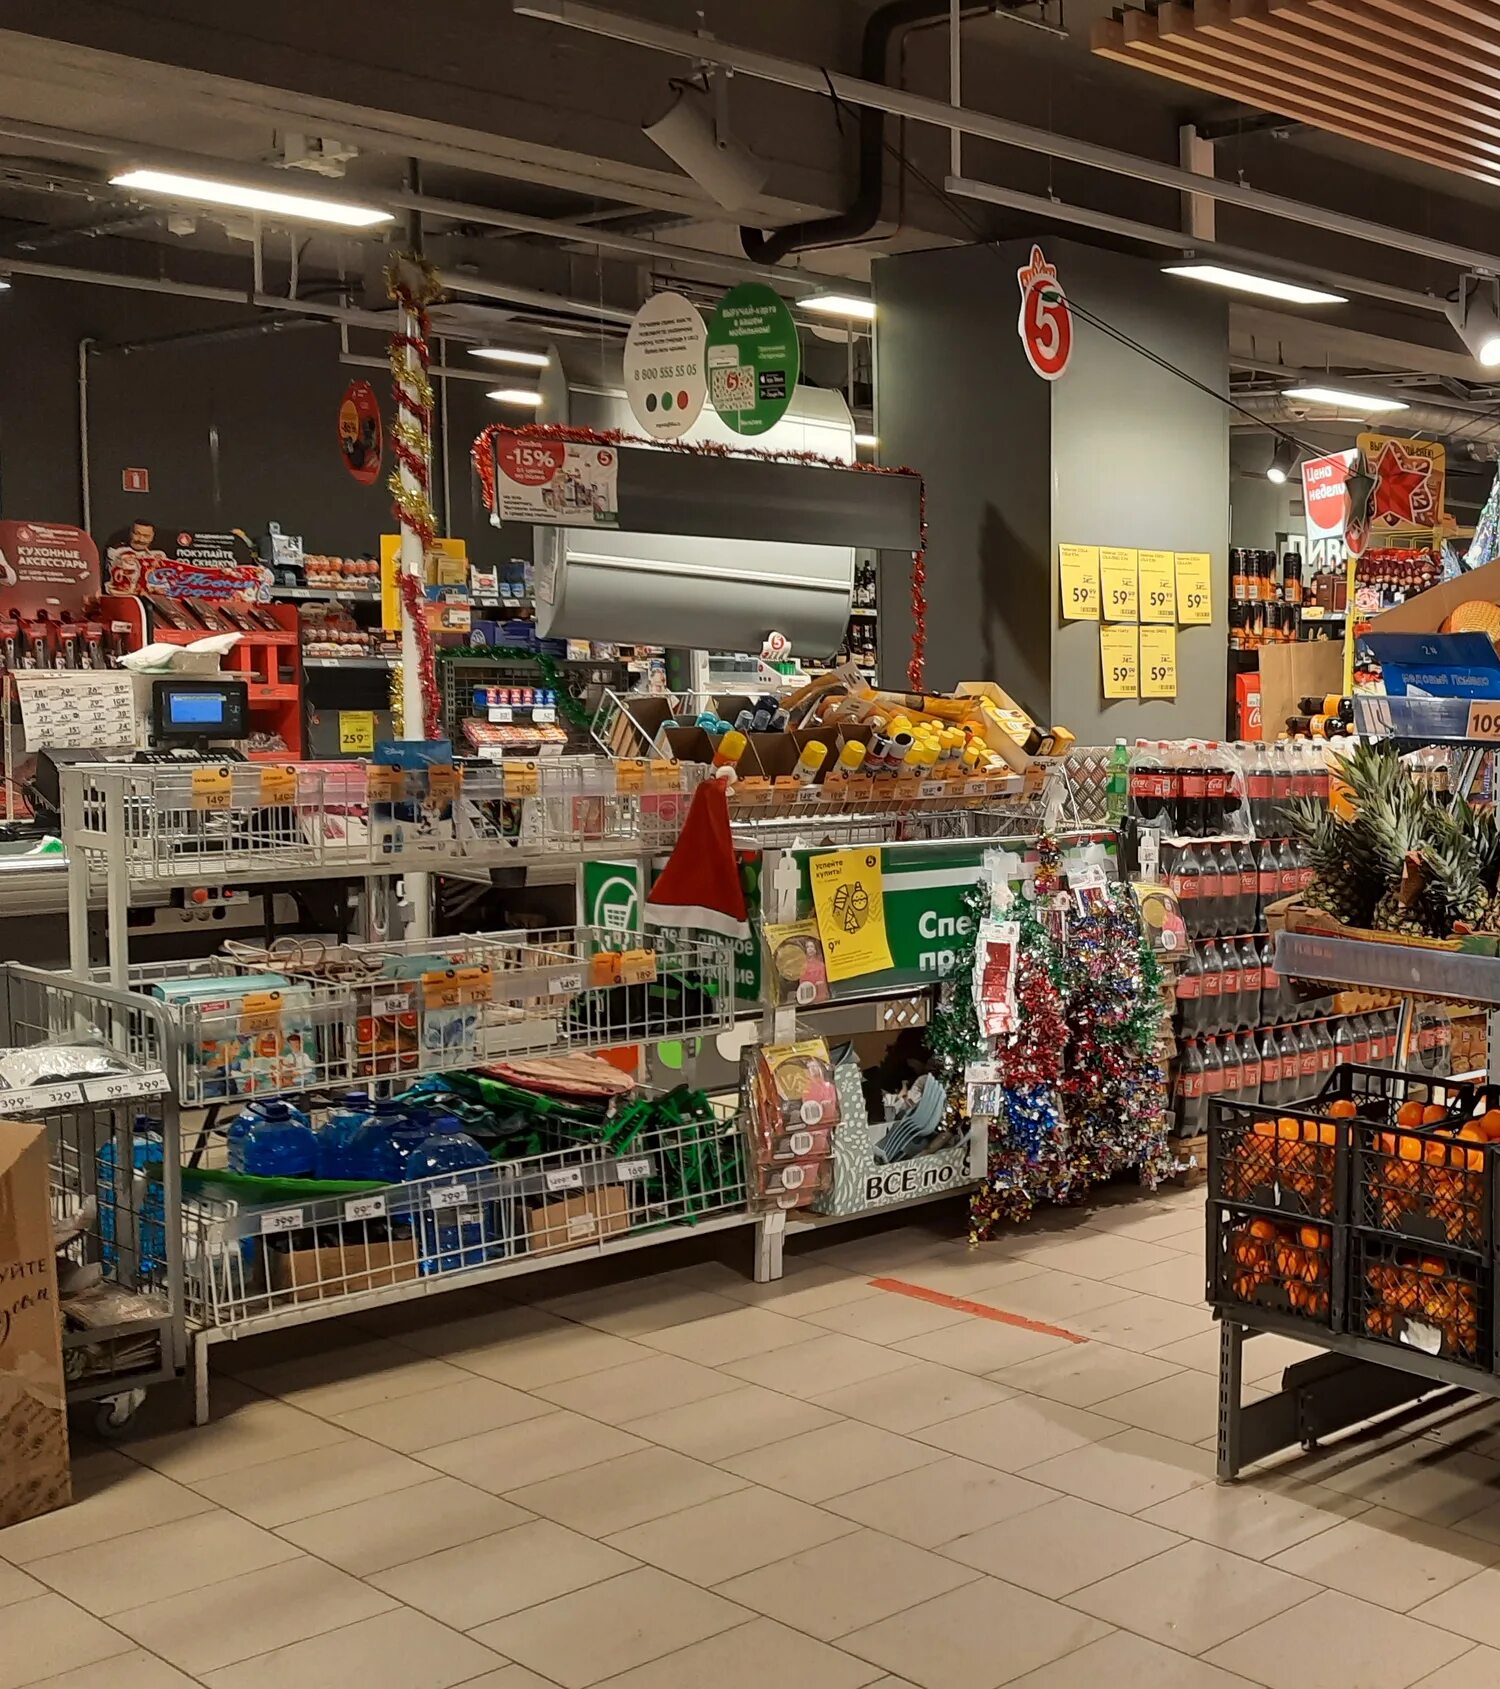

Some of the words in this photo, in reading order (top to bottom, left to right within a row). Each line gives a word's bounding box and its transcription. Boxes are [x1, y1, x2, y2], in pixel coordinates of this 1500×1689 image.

[634, 367, 640, 381] 8
[642, 366, 658, 380] 800
[659, 365, 674, 378] 555
[675, 365, 685, 377] 55
[686, 364, 697, 376] 05
[505, 447, 556, 468] -15%
[1306, 464, 1333, 483] Цена
[17, 545, 81, 560] КУХОННЫЕ
[176, 548, 234, 560] ПОКУПАЙТЕ
[18, 556, 88, 570] АКСЕССУАРЫ
[1073, 587, 1089, 603] 59
[1112, 590, 1128, 605] 59
[1150, 592, 1165, 607] 59
[1187, 594, 1202, 609] 59
[1112, 667, 1128, 682] 59
[1151, 666, 1166, 681] 59
[342, 734, 364, 744] 259
[206, 795, 224, 806] 149
[815, 859, 843, 871] Успейте
[816, 868, 842, 880] купить!
[918, 910, 973, 940] Спе
[107, 1085, 123, 1095] 99
[136, 1080, 160, 1092] 299
[48, 1091, 72, 1103] 329
[865, 1167, 917, 1201] ВСЕ
[923, 1164, 953, 1188] по
